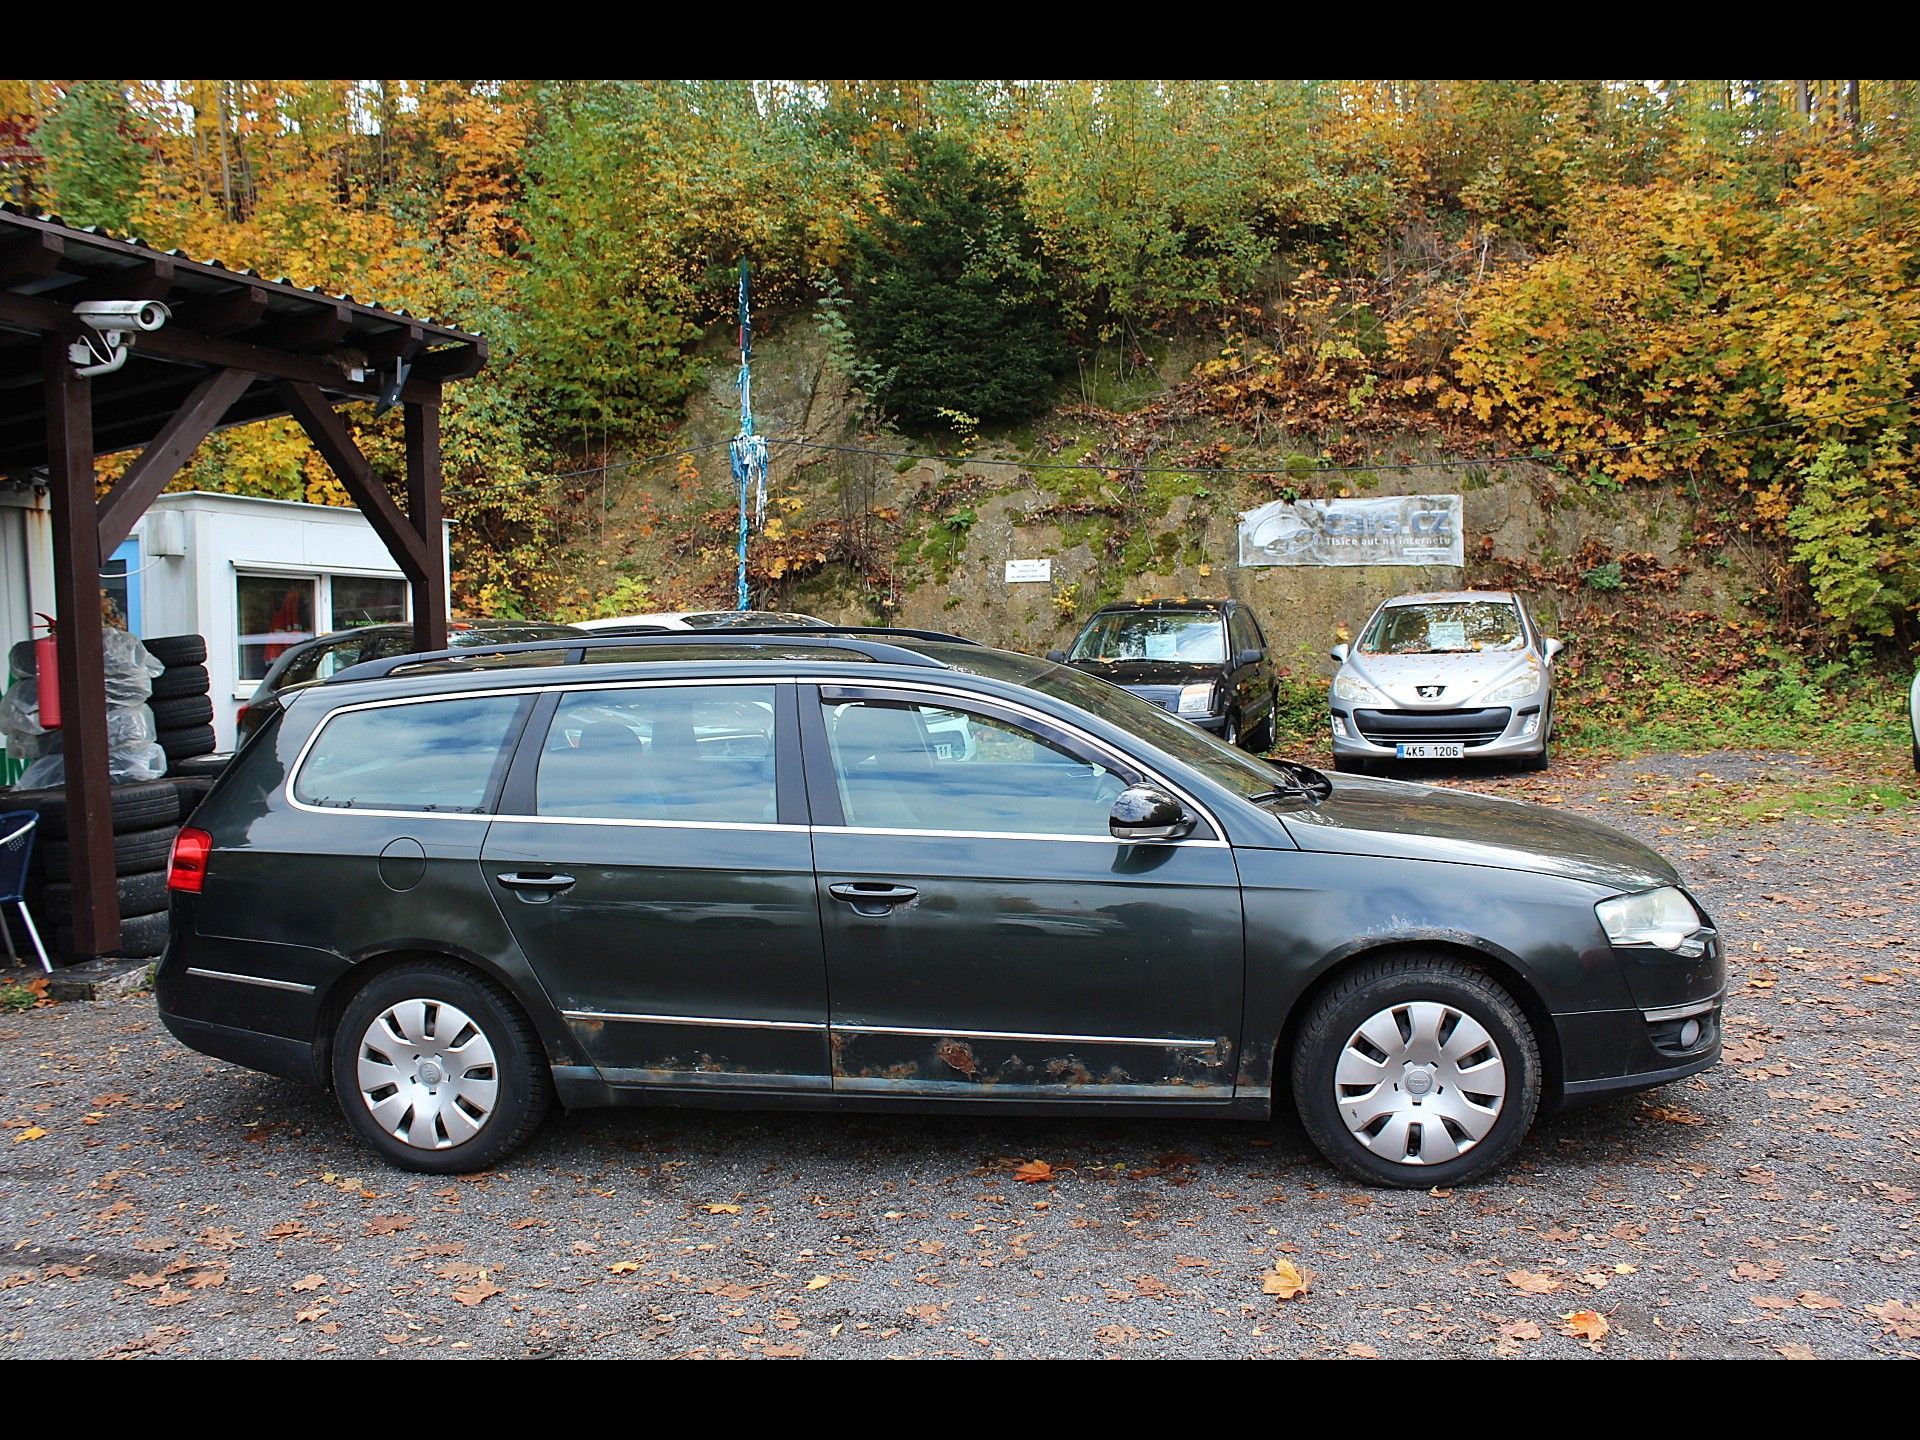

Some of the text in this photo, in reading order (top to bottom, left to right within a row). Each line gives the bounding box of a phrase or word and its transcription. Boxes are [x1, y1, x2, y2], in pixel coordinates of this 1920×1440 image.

[1362, 536, 1379, 546] aut
[1406, 746, 1459, 757] 4K5 1206
